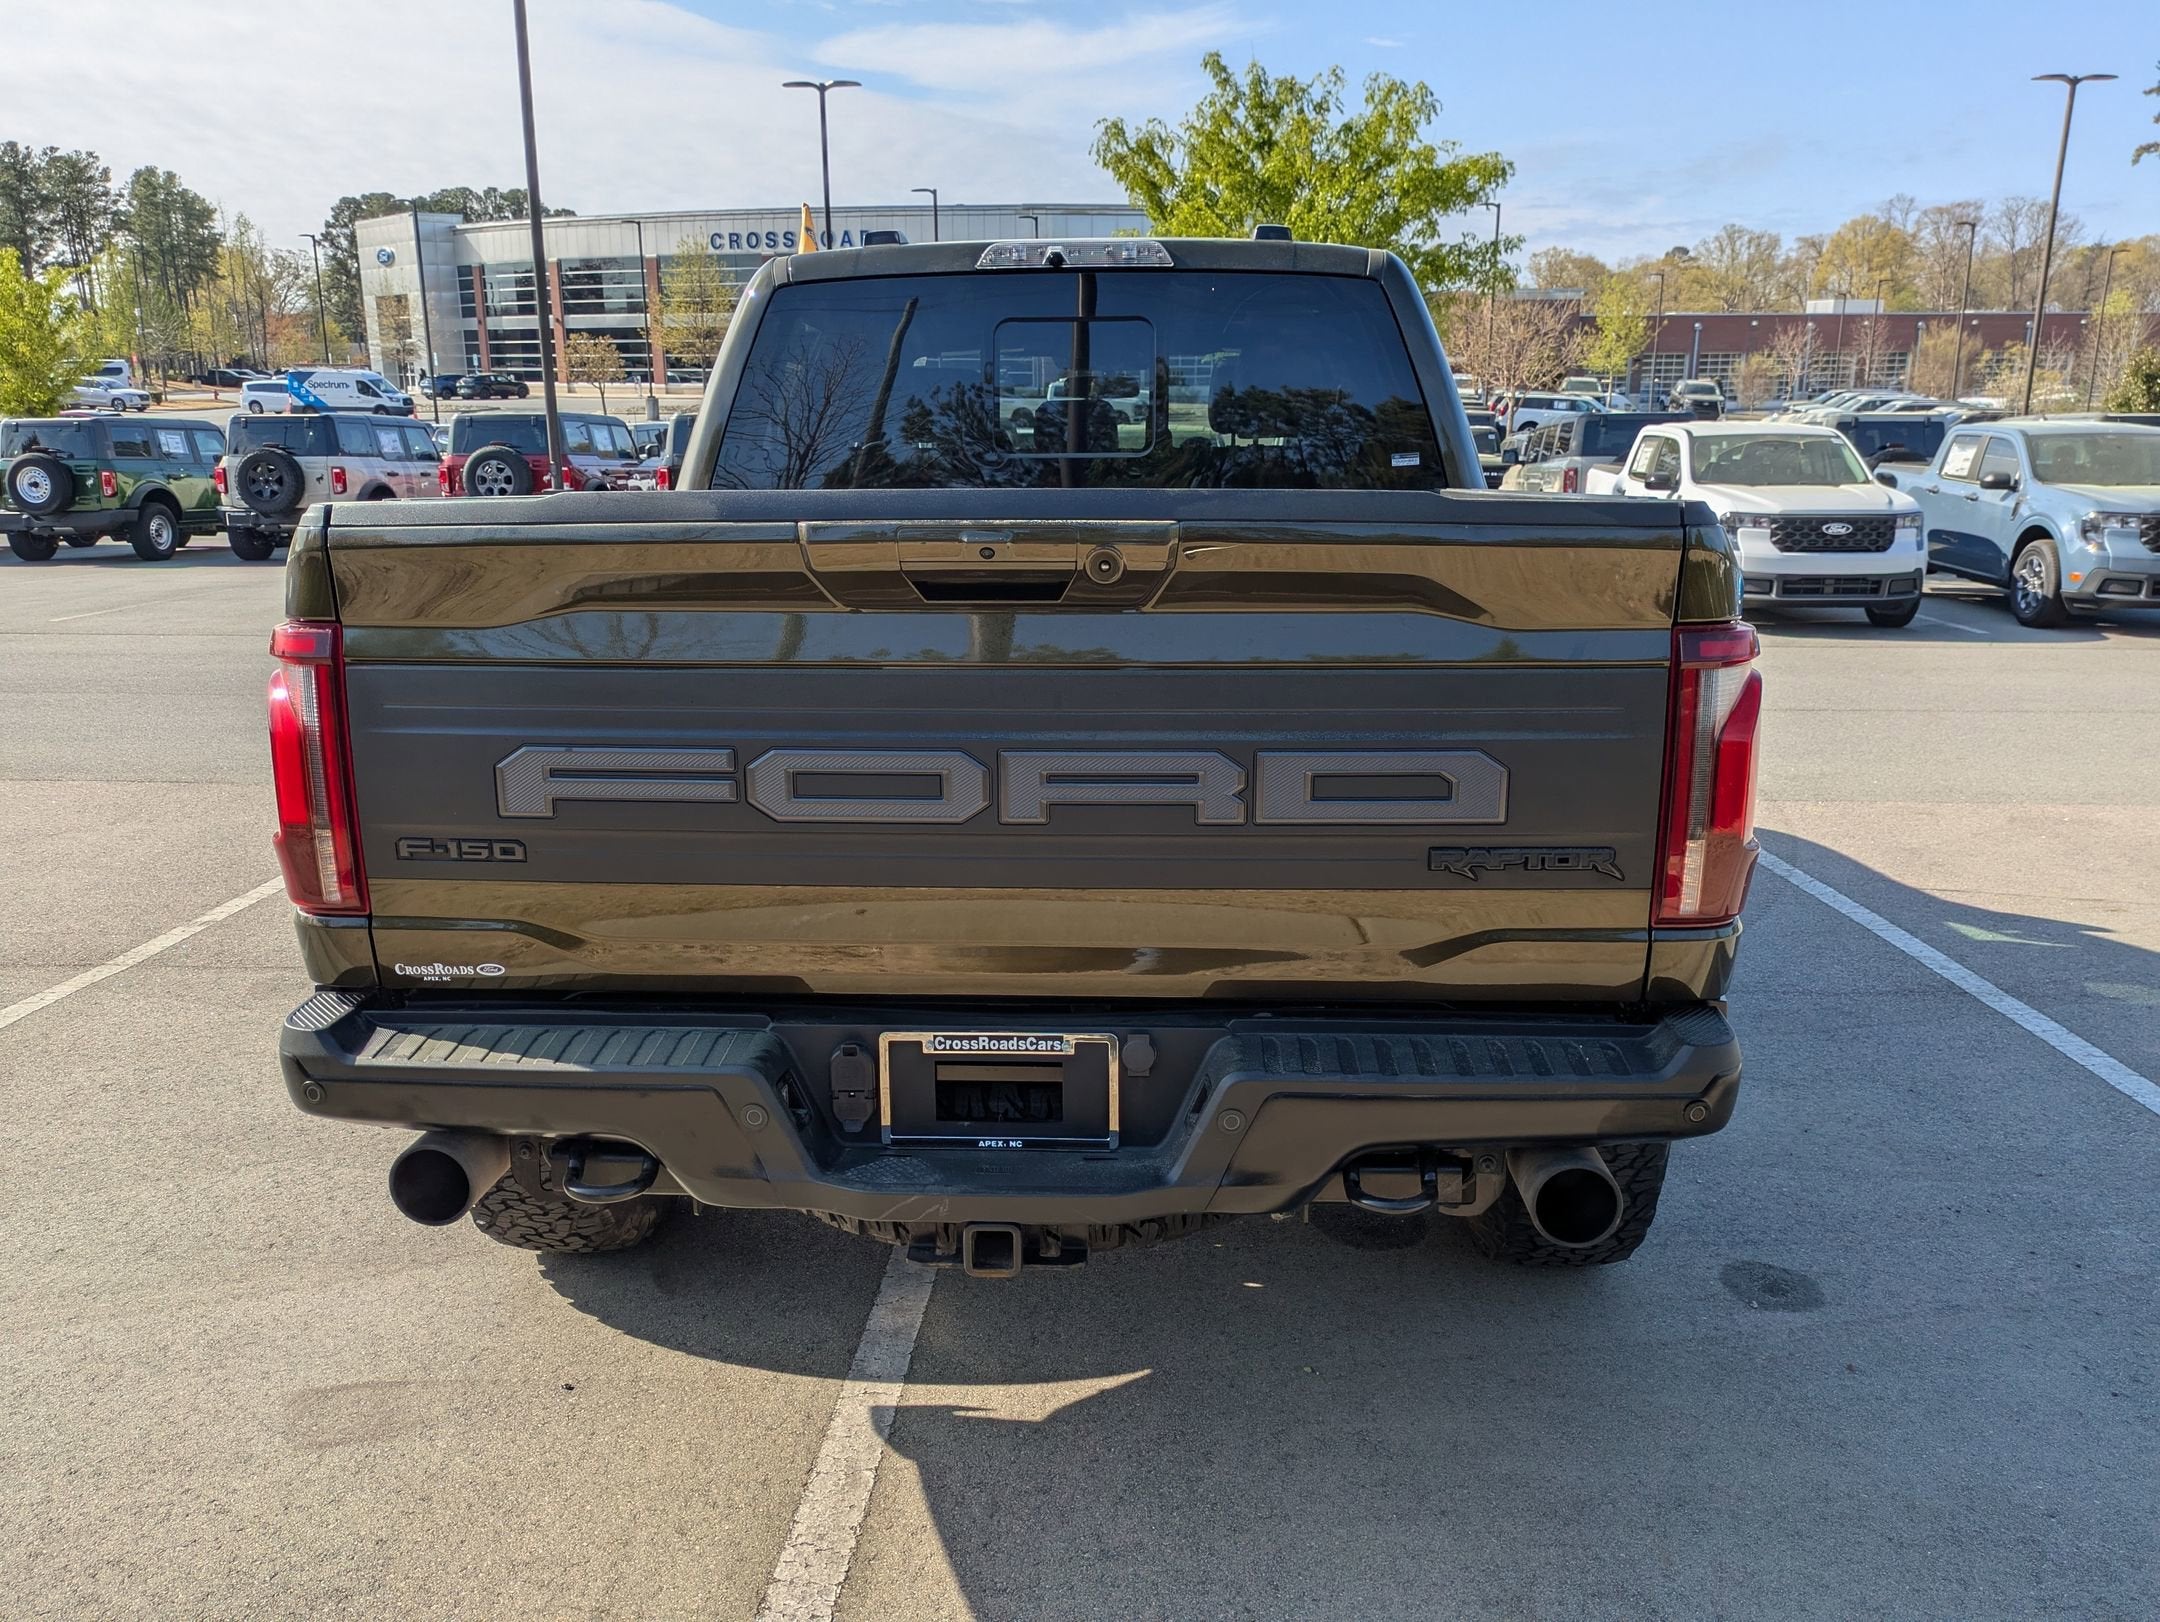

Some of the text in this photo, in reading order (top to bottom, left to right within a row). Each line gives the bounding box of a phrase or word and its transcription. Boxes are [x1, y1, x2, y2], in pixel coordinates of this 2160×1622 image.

[307, 380, 349, 390] Spectrum
[494, 743, 1511, 826] FORD
[395, 837, 527, 863] F-150
[1428, 847, 1625, 881] RAPTOR
[935, 1037, 1061, 1050] CrossRoadsCars
[1009, 1140, 1023, 1148] NC
